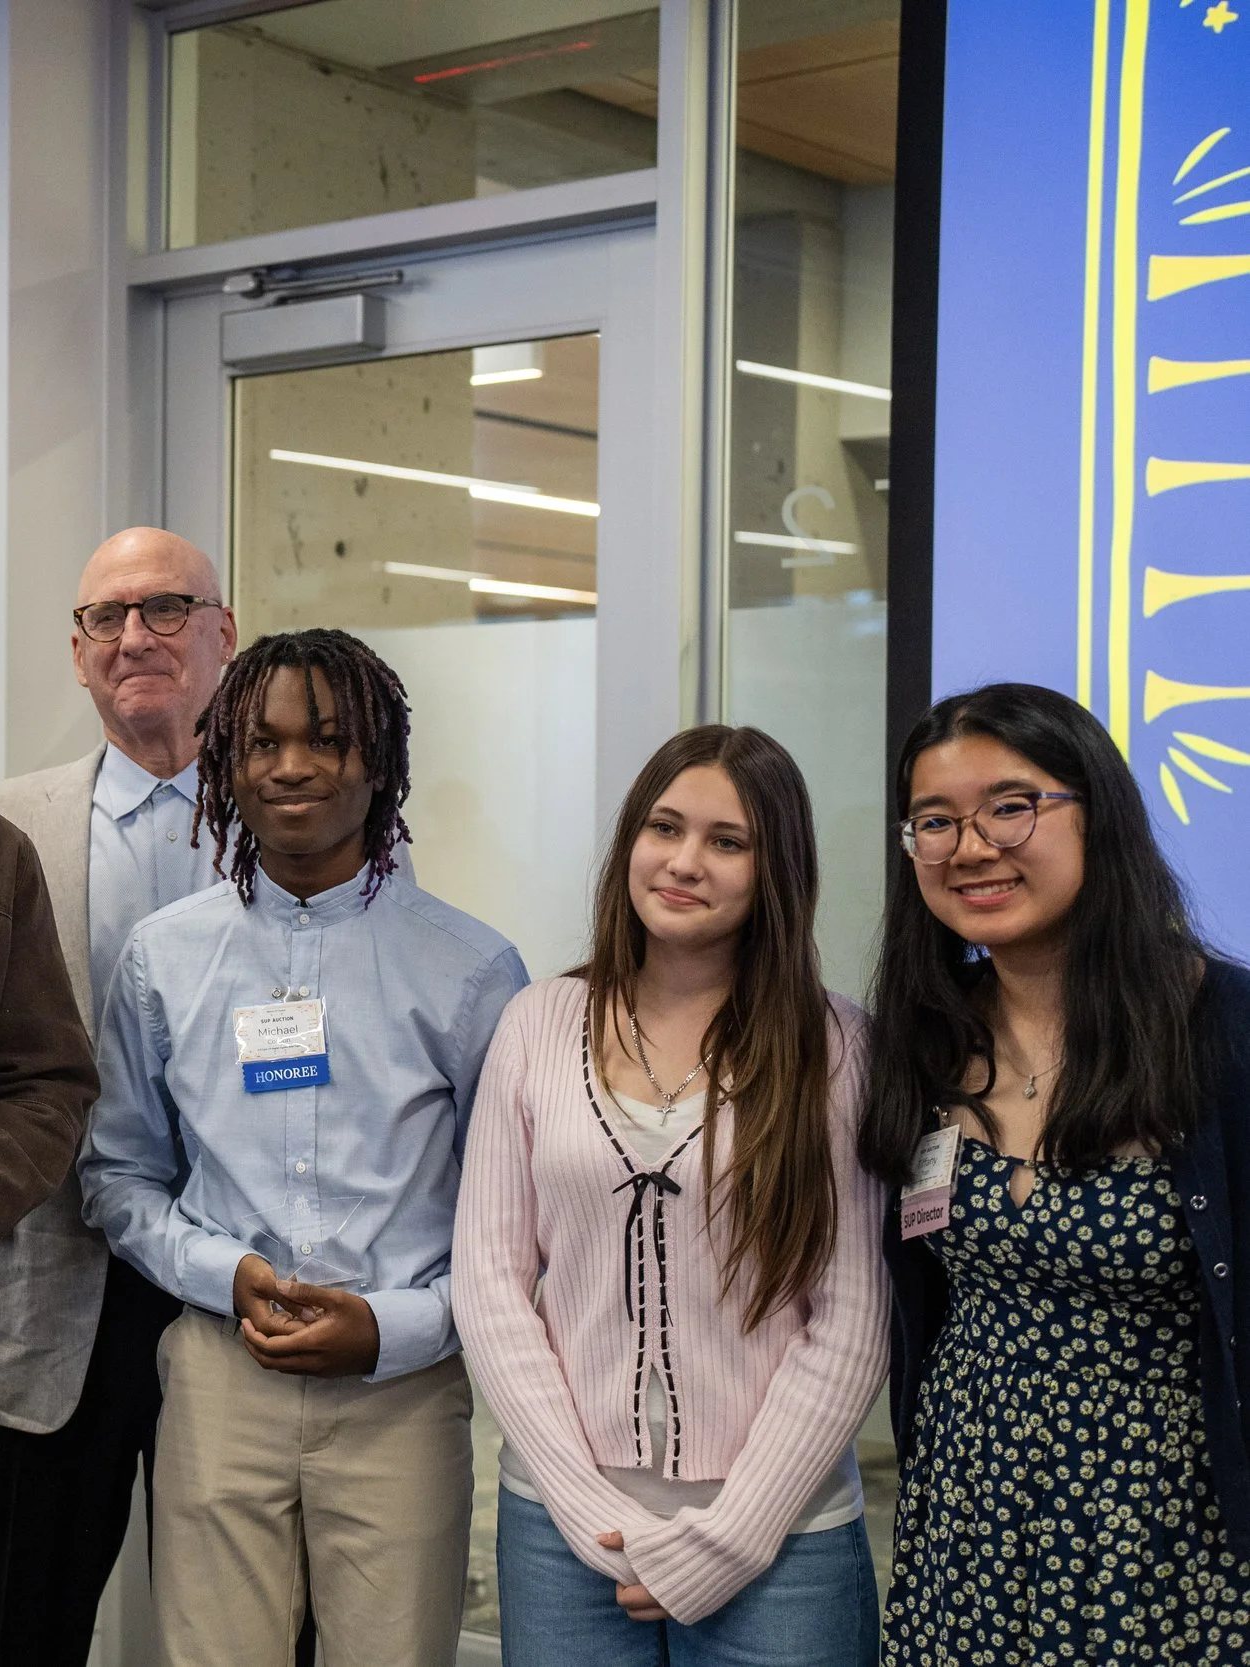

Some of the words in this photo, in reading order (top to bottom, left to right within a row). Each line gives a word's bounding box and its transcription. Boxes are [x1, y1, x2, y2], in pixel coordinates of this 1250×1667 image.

[258, 1025, 299, 1037] Michael
[255, 1065, 318, 1083] HONOREE
[904, 1212, 916, 1228] SUP
[916, 1206, 944, 1226] Director
